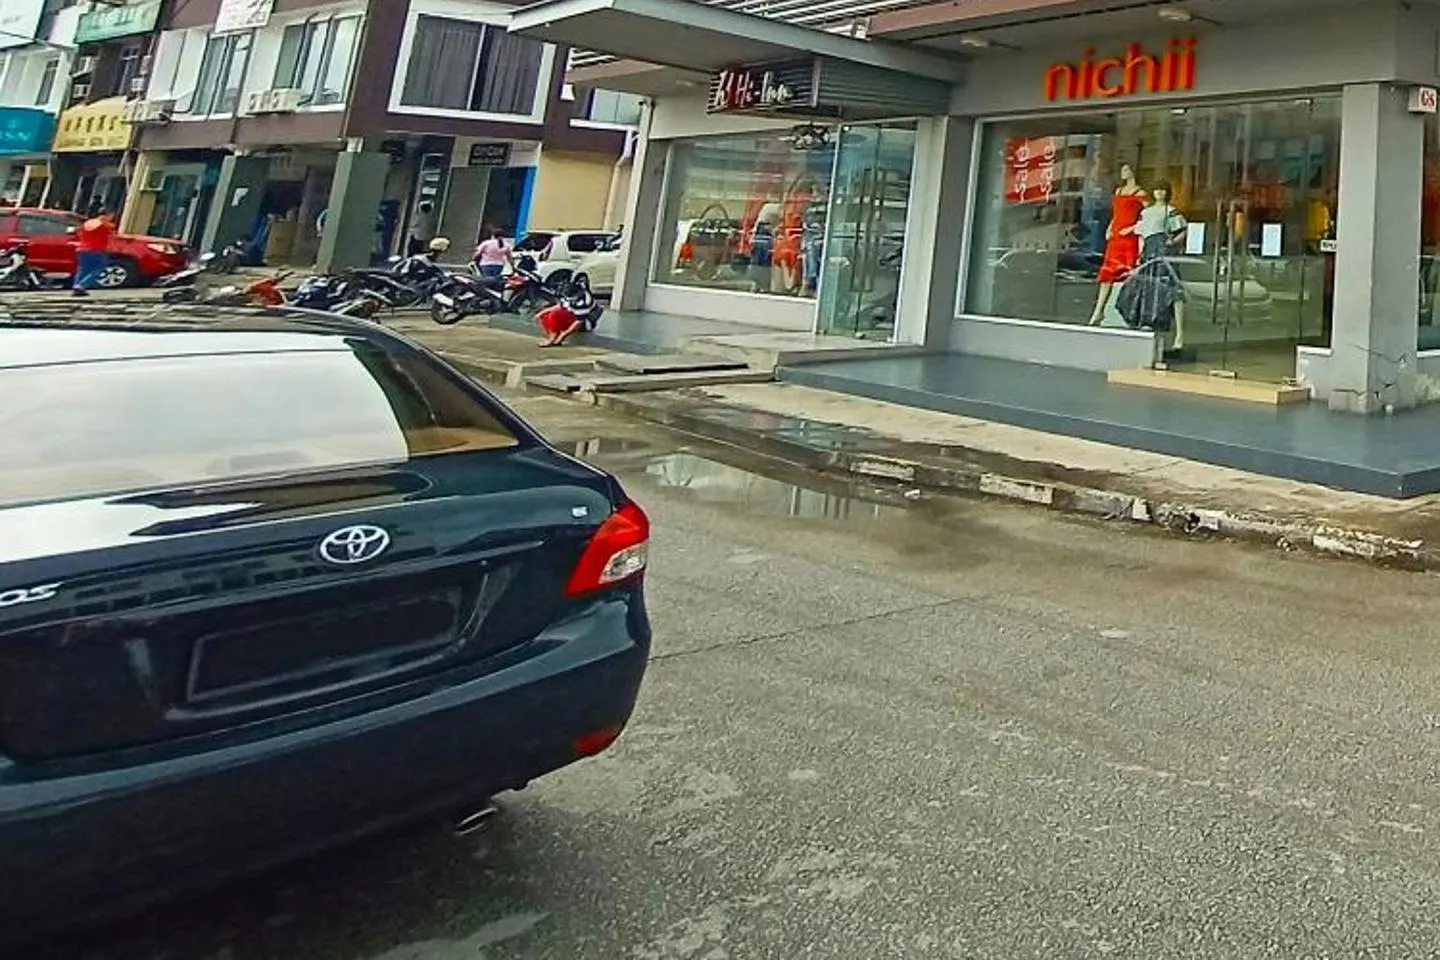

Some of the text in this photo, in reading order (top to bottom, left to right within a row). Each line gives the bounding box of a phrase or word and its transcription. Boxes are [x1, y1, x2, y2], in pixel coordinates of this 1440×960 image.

[1044, 37, 1198, 102] nichii
[1013, 143, 1031, 198] sale
[1038, 142, 1058, 196] sale
